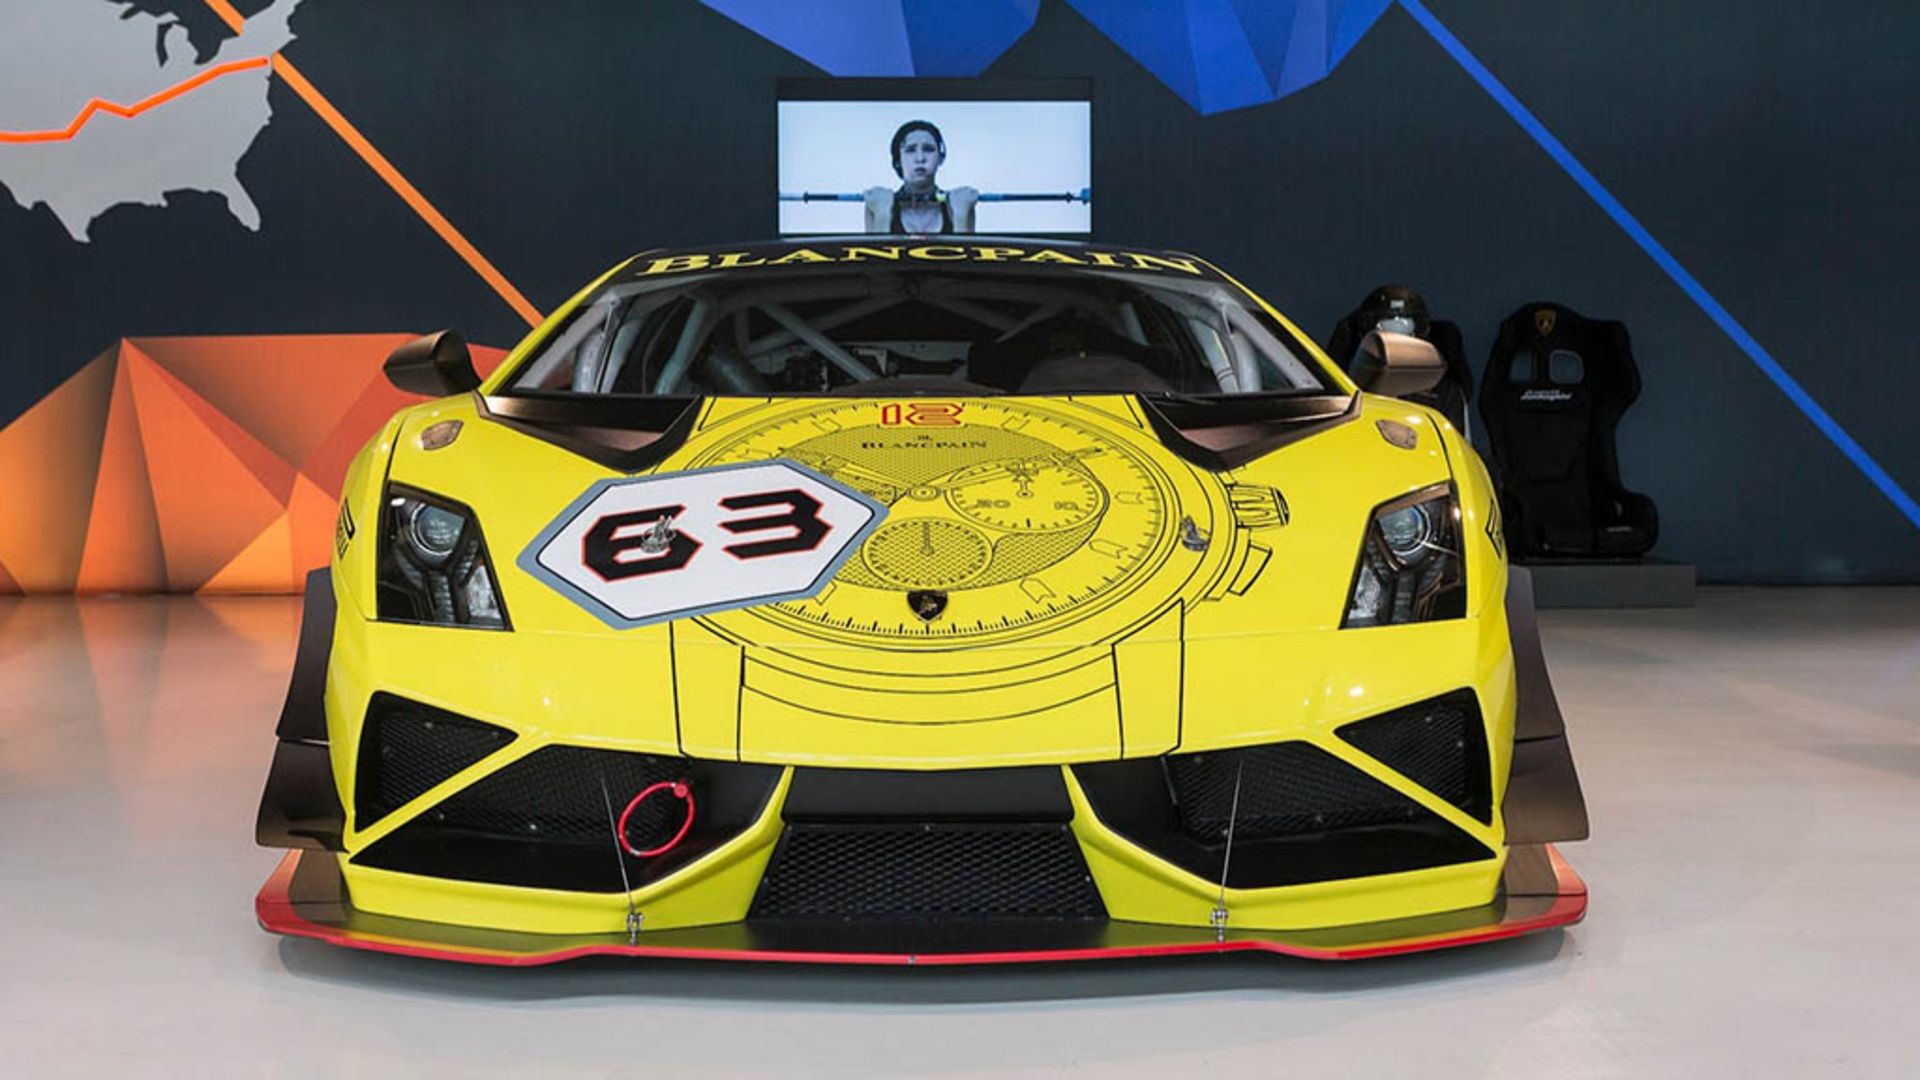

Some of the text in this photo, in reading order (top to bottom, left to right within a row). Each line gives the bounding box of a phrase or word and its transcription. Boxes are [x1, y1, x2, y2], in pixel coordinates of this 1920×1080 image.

[637, 247, 1202, 275] BLANCPAIN
[881, 403, 963, 425] 12
[861, 441, 988, 449] BLANCPAIN
[582, 487, 833, 583] 63
